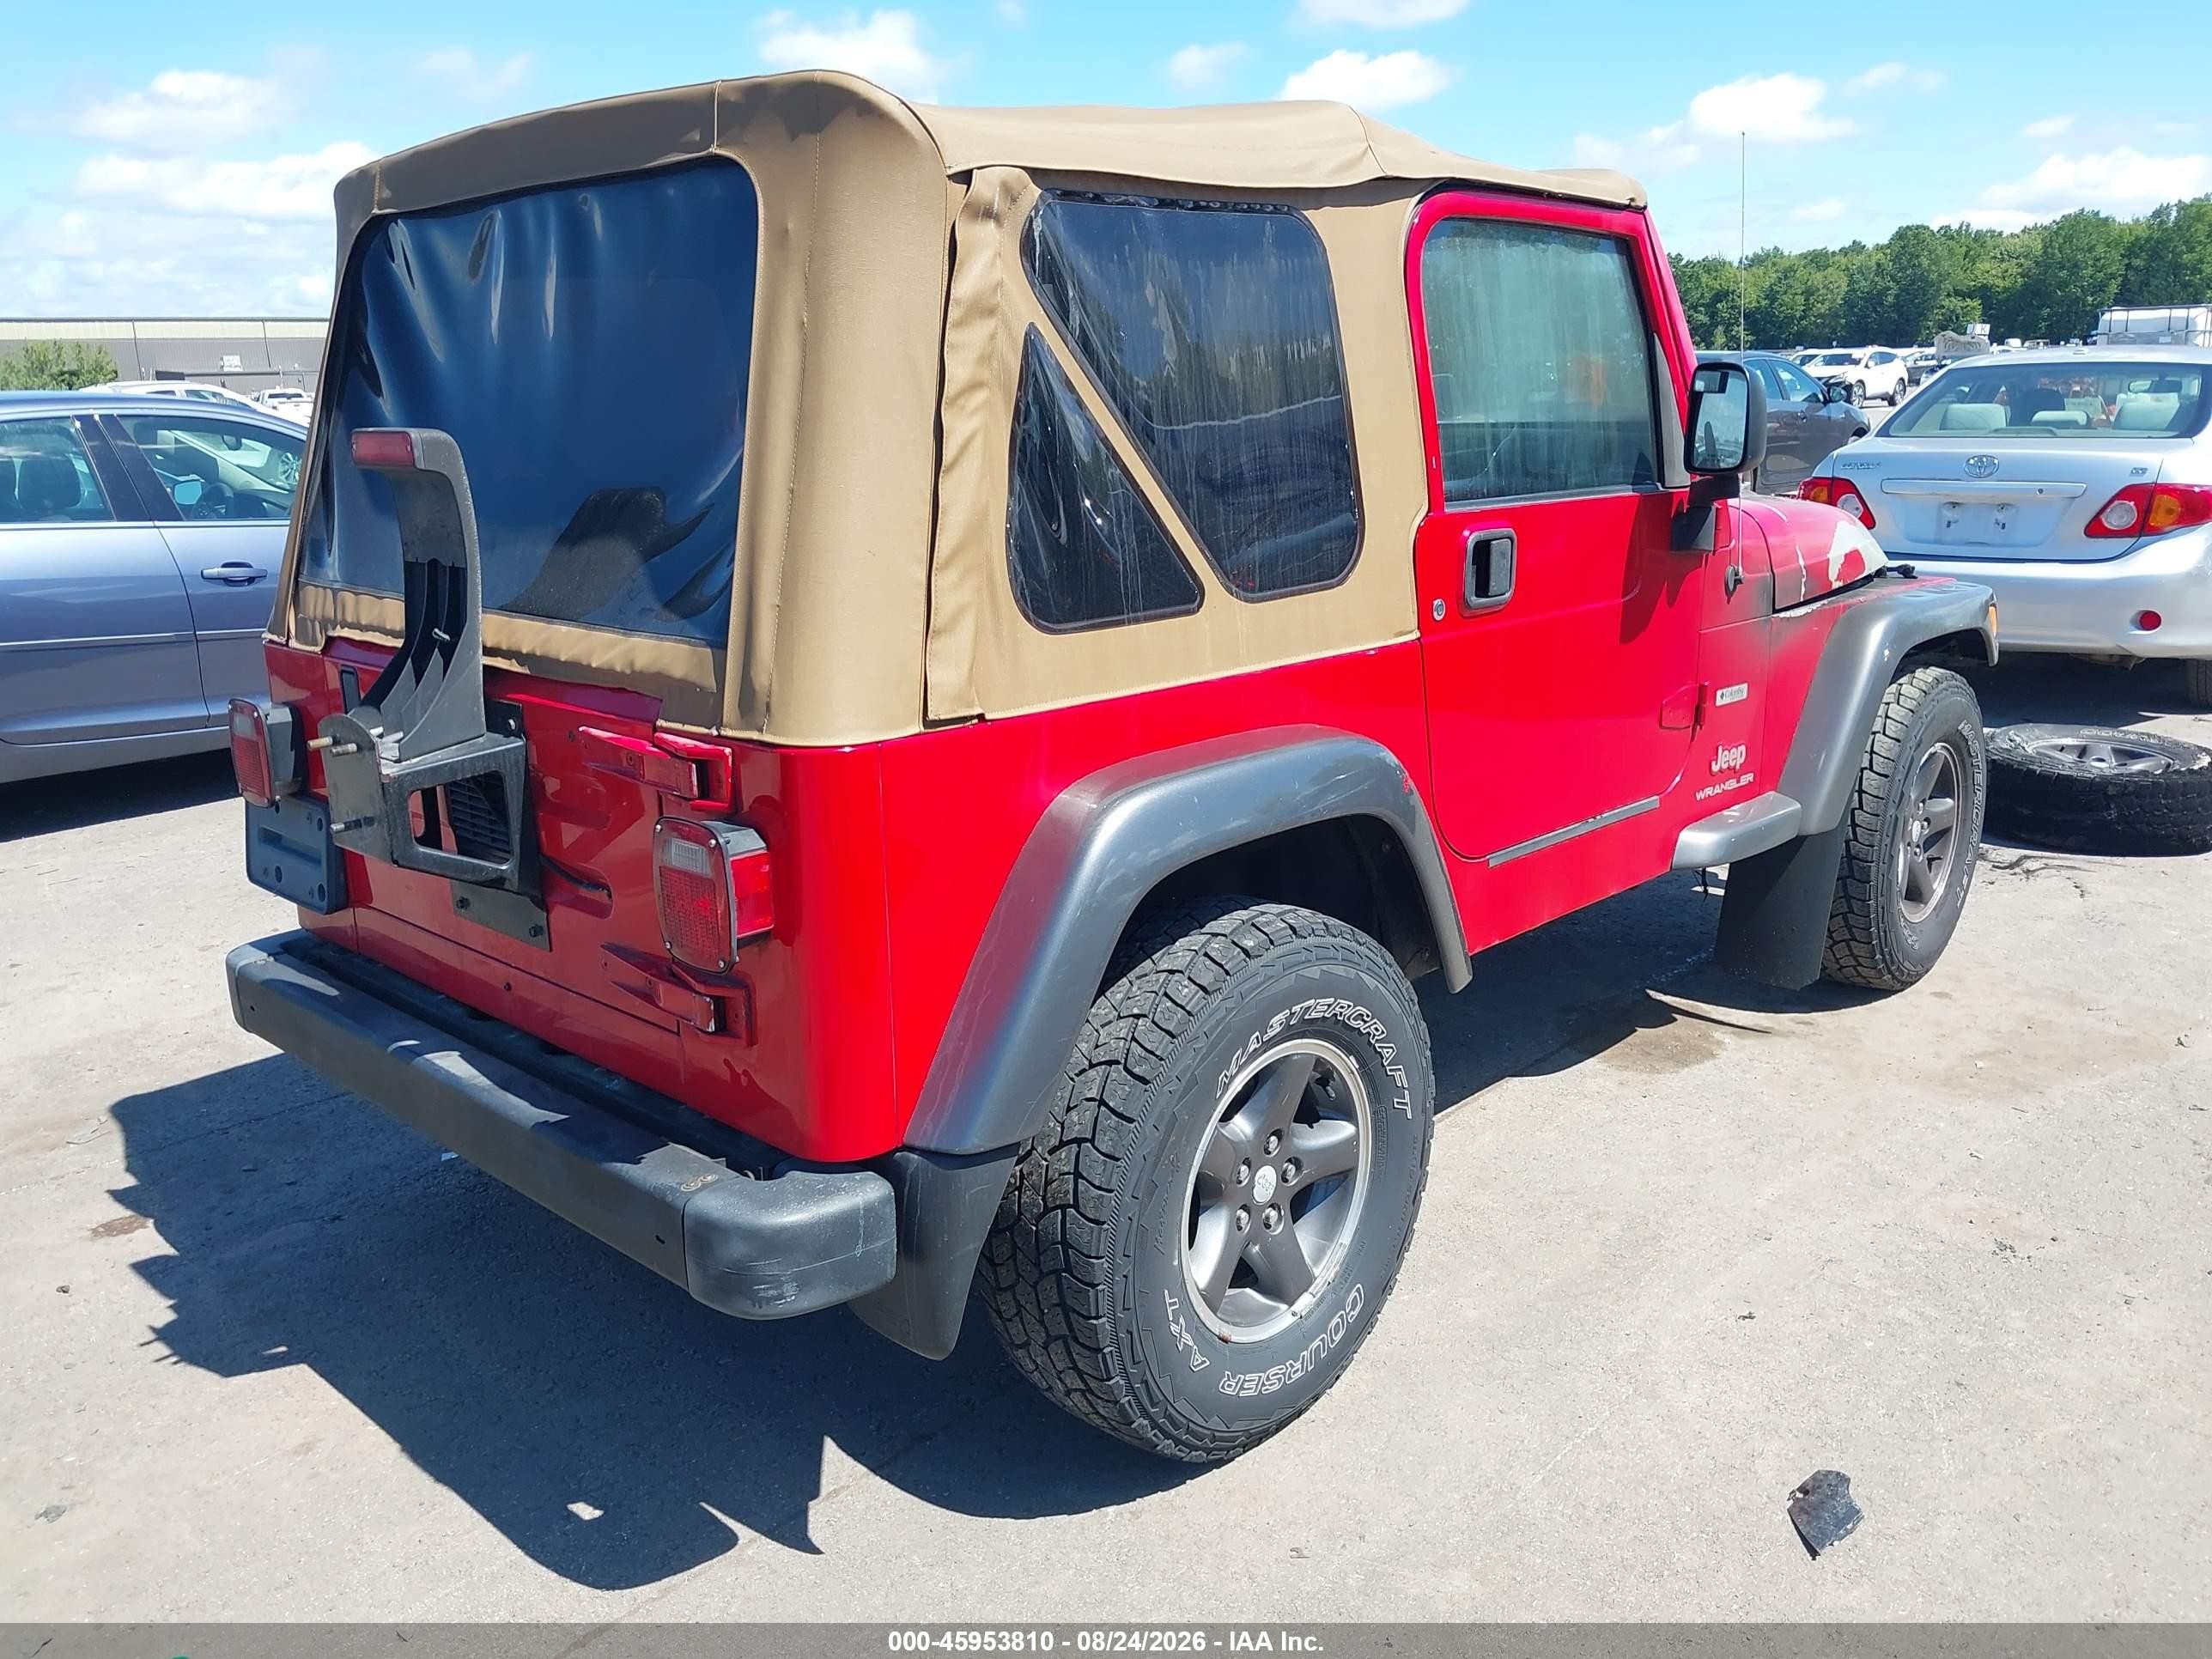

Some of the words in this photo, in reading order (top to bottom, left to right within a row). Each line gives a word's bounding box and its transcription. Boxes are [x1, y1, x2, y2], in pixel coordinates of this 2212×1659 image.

[1695, 773, 1754, 801] WRANGLER
[1711, 744, 1747, 773] Jeep
[1957, 720, 1983, 908] MASTERCRAFT
[1216, 998, 1413, 1120] MASTERCRAFT
[1164, 1290, 1210, 1372] AXT
[1218, 1283, 1364, 1397] COURSER
